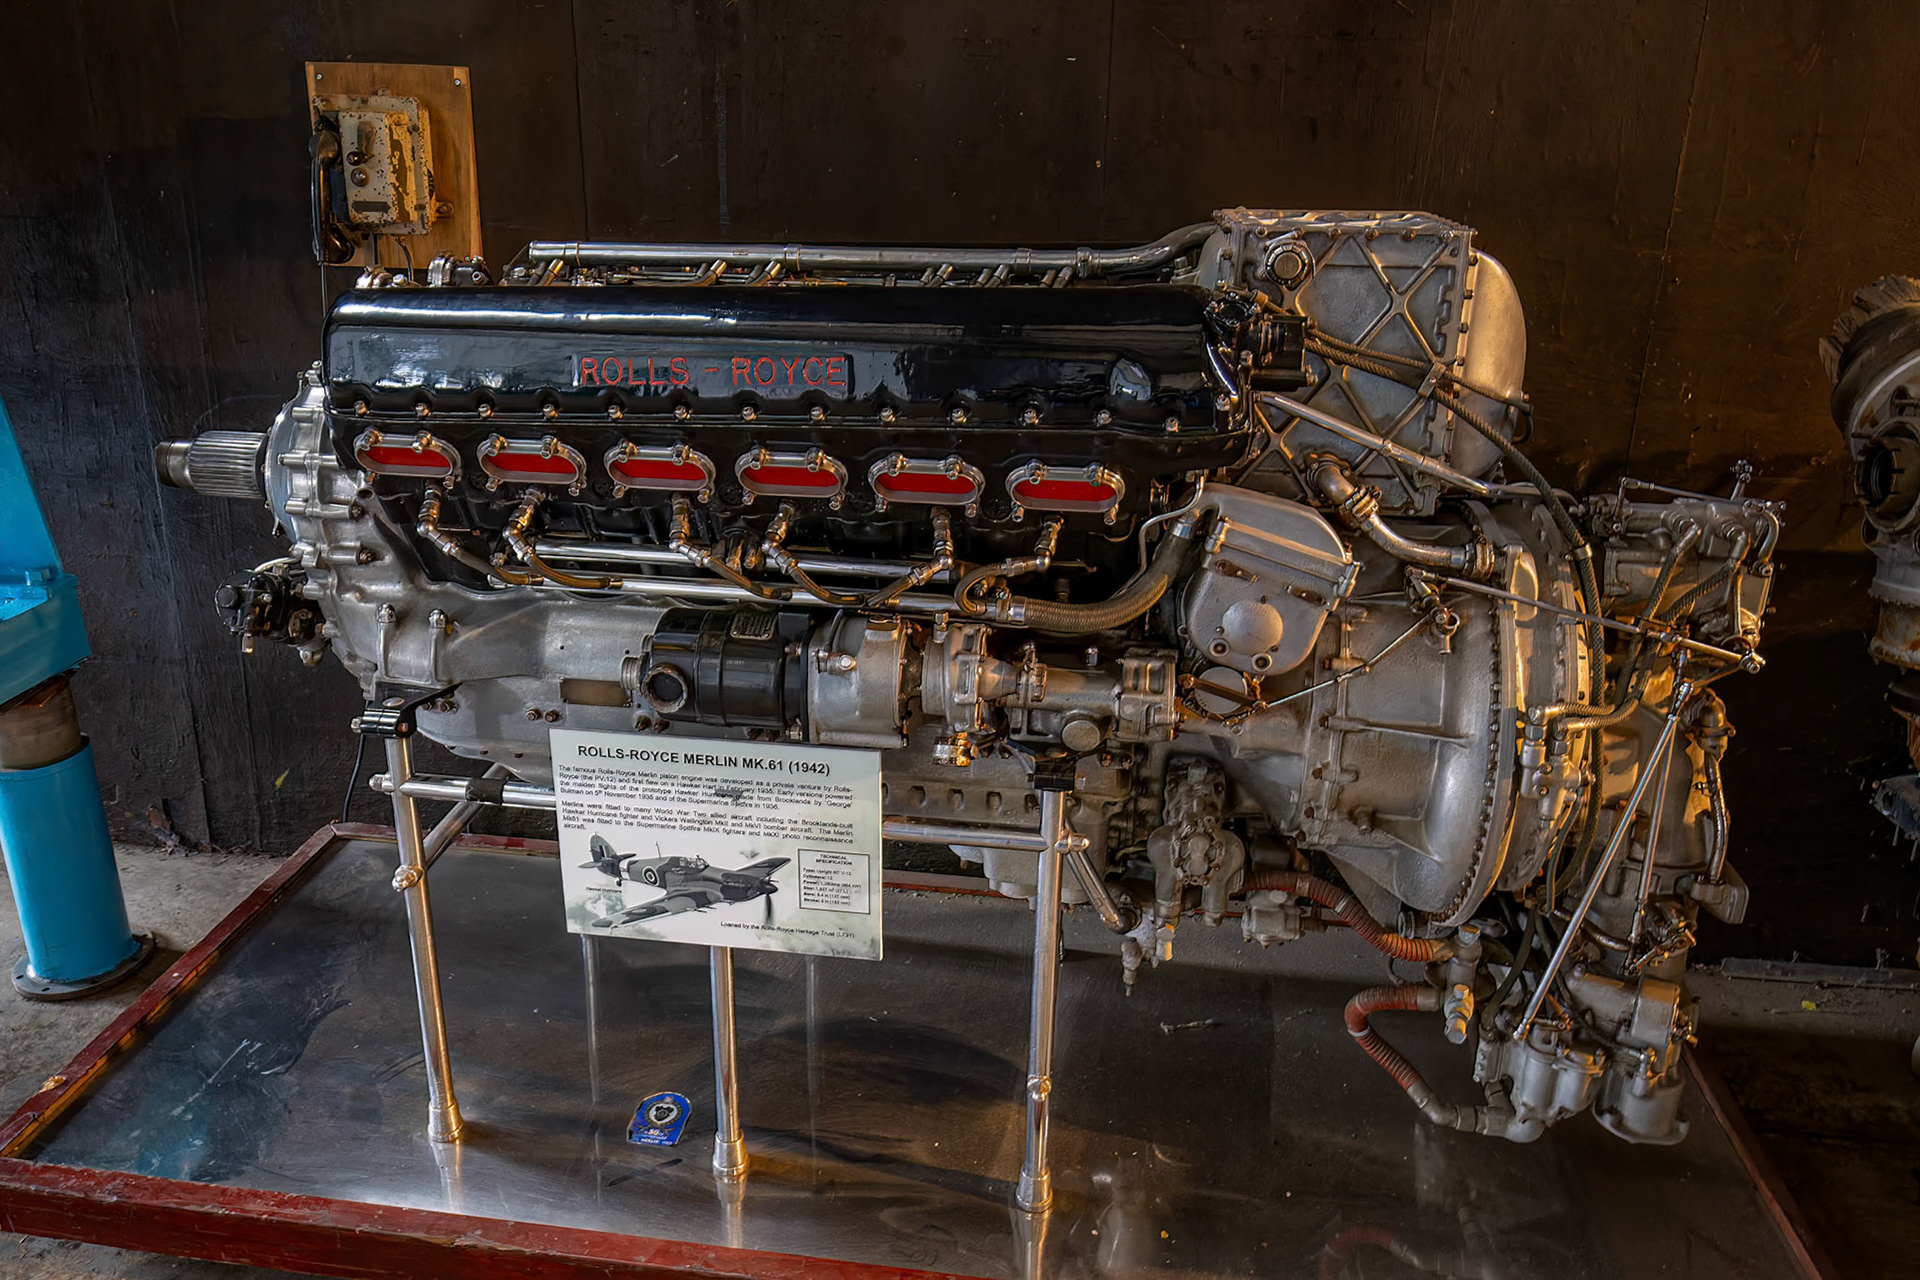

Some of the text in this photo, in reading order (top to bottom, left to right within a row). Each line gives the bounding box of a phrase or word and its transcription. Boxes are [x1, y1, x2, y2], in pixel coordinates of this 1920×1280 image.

[580, 356, 690, 387] ROLLS
[731, 356, 847, 387] ROYCE
[578, 746, 830, 776] ROLLS-ROYCE MERLIN MK.61 (1942)
[559, 773, 579, 781] Royce
[825, 792, 852, 801] powered
[598, 768, 635, 778] Rolls-Royce
[660, 772, 678, 781] piston
[681, 774, 702, 783] engine
[720, 777, 753, 786] developed
[773, 780, 794, 789] private
[598, 783, 616, 791] flights
[642, 786, 671, 795] prototype
[775, 796, 810, 804] Brooklands
[688, 797, 729, 807] Supermarine
[730, 800, 752, 808] Spitfire
[619, 812, 639, 820] fighter
[680, 817, 713, 826] Wellington
[756, 815, 784, 824] including
[802, 819, 853, 828] Brooklands-built
[636, 821, 676, 830] Supermarine
[679, 824, 701, 832] Spitfire
[722, 827, 745, 836] fighters
[782, 832, 800, 840] photo
[803, 833, 853, 843] reconnaissance
